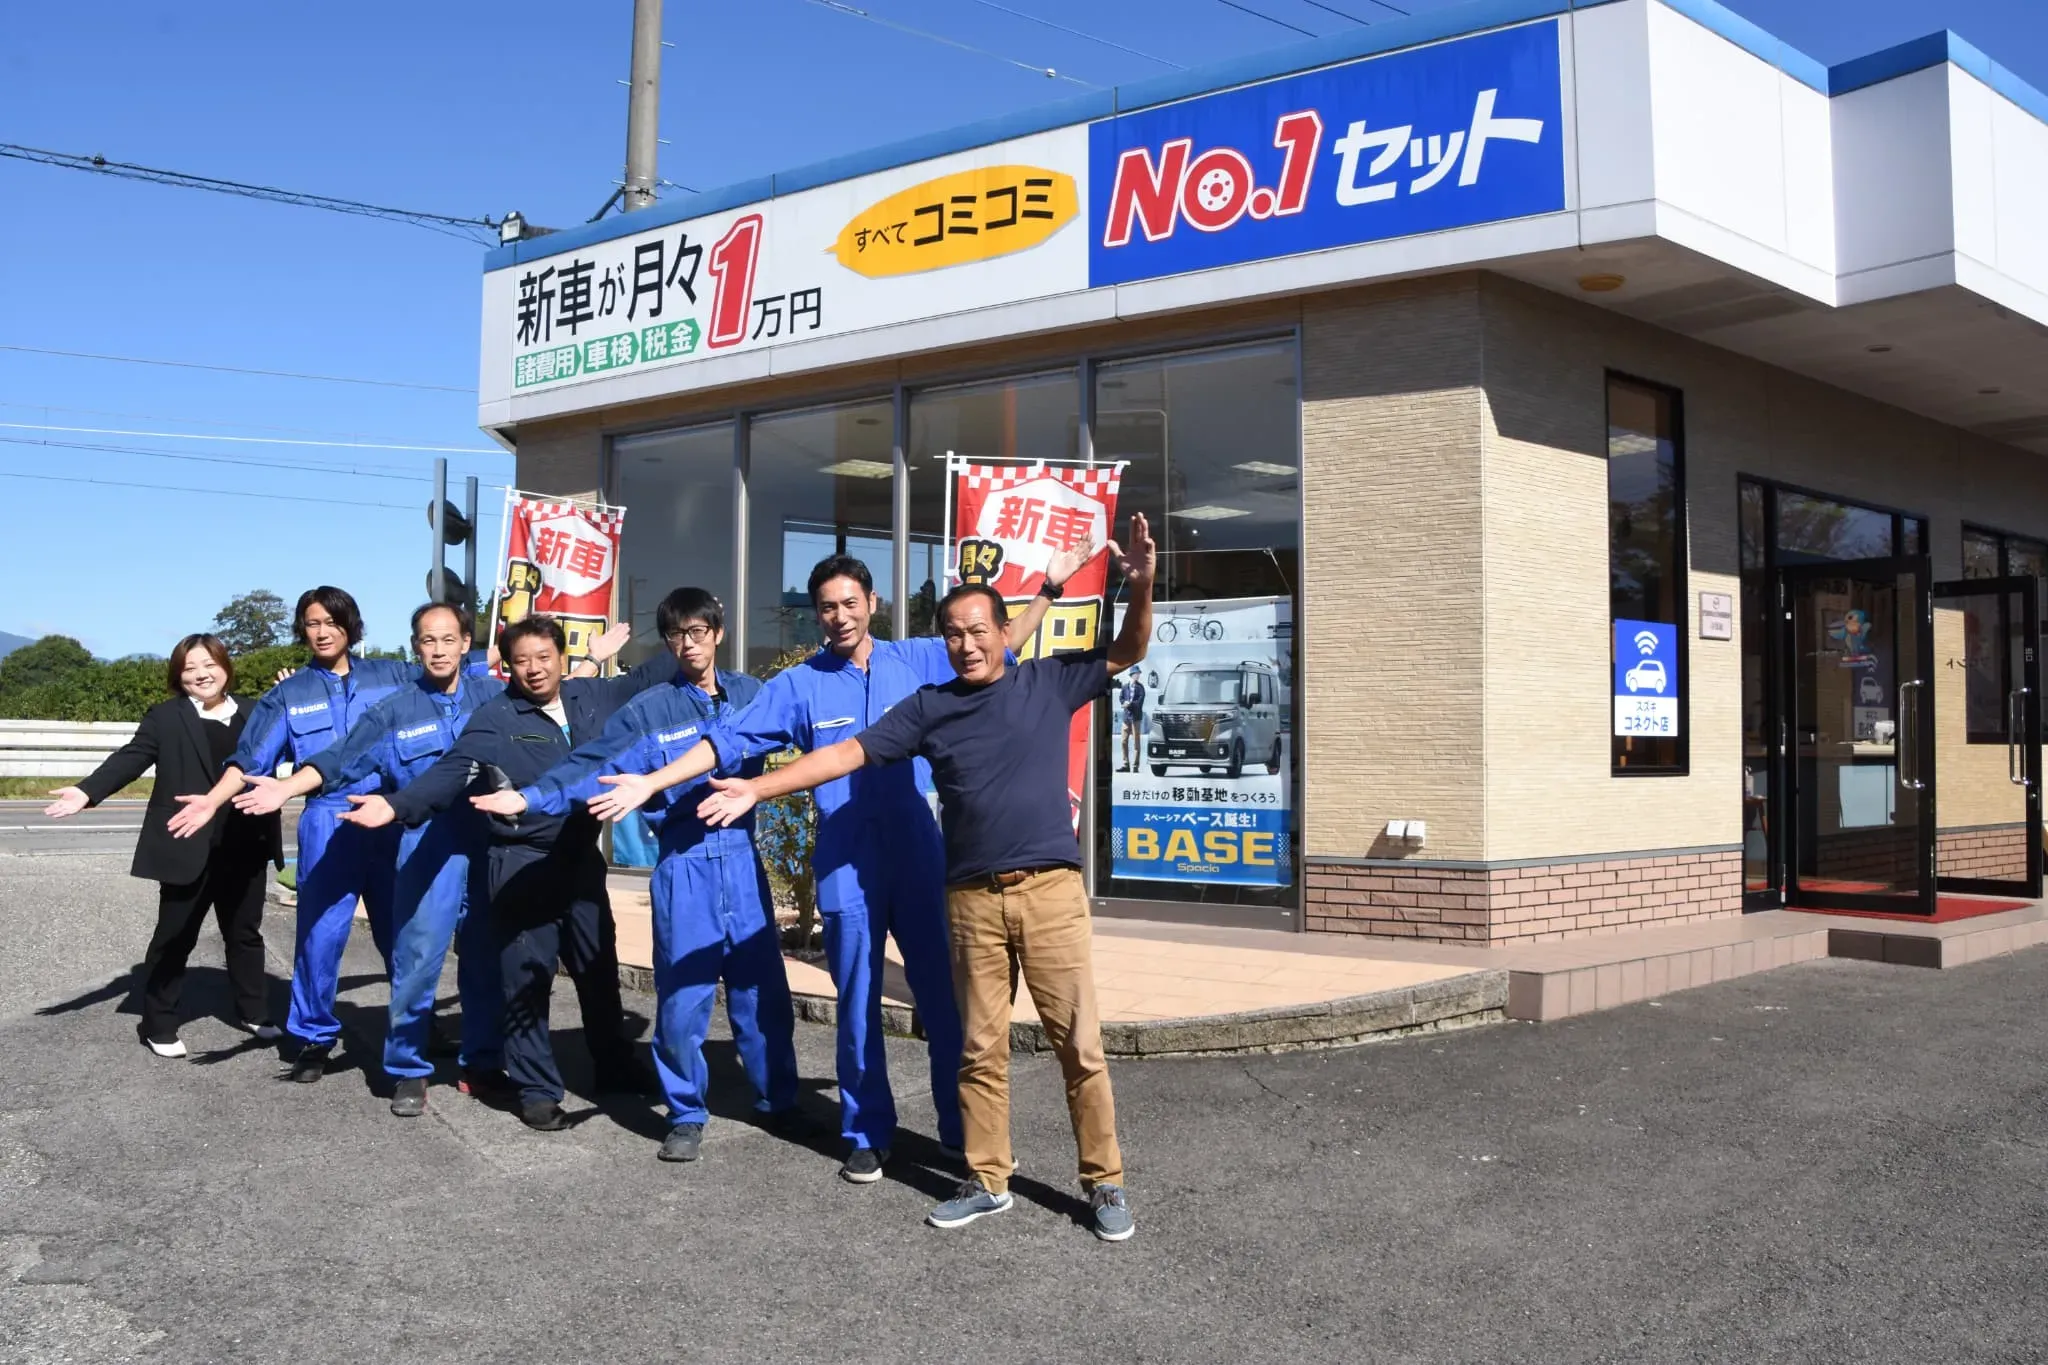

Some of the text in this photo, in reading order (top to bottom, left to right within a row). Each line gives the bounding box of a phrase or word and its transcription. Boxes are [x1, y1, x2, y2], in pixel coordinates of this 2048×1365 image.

[1334, 88, 1544, 206] セット
[992, 495, 1095, 553] 新車
[535, 527, 607, 580] 新車
[961, 544, 997, 573] 月々
[1624, 716, 1669, 732] コネクト店
[1127, 827, 1275, 866] BASE
